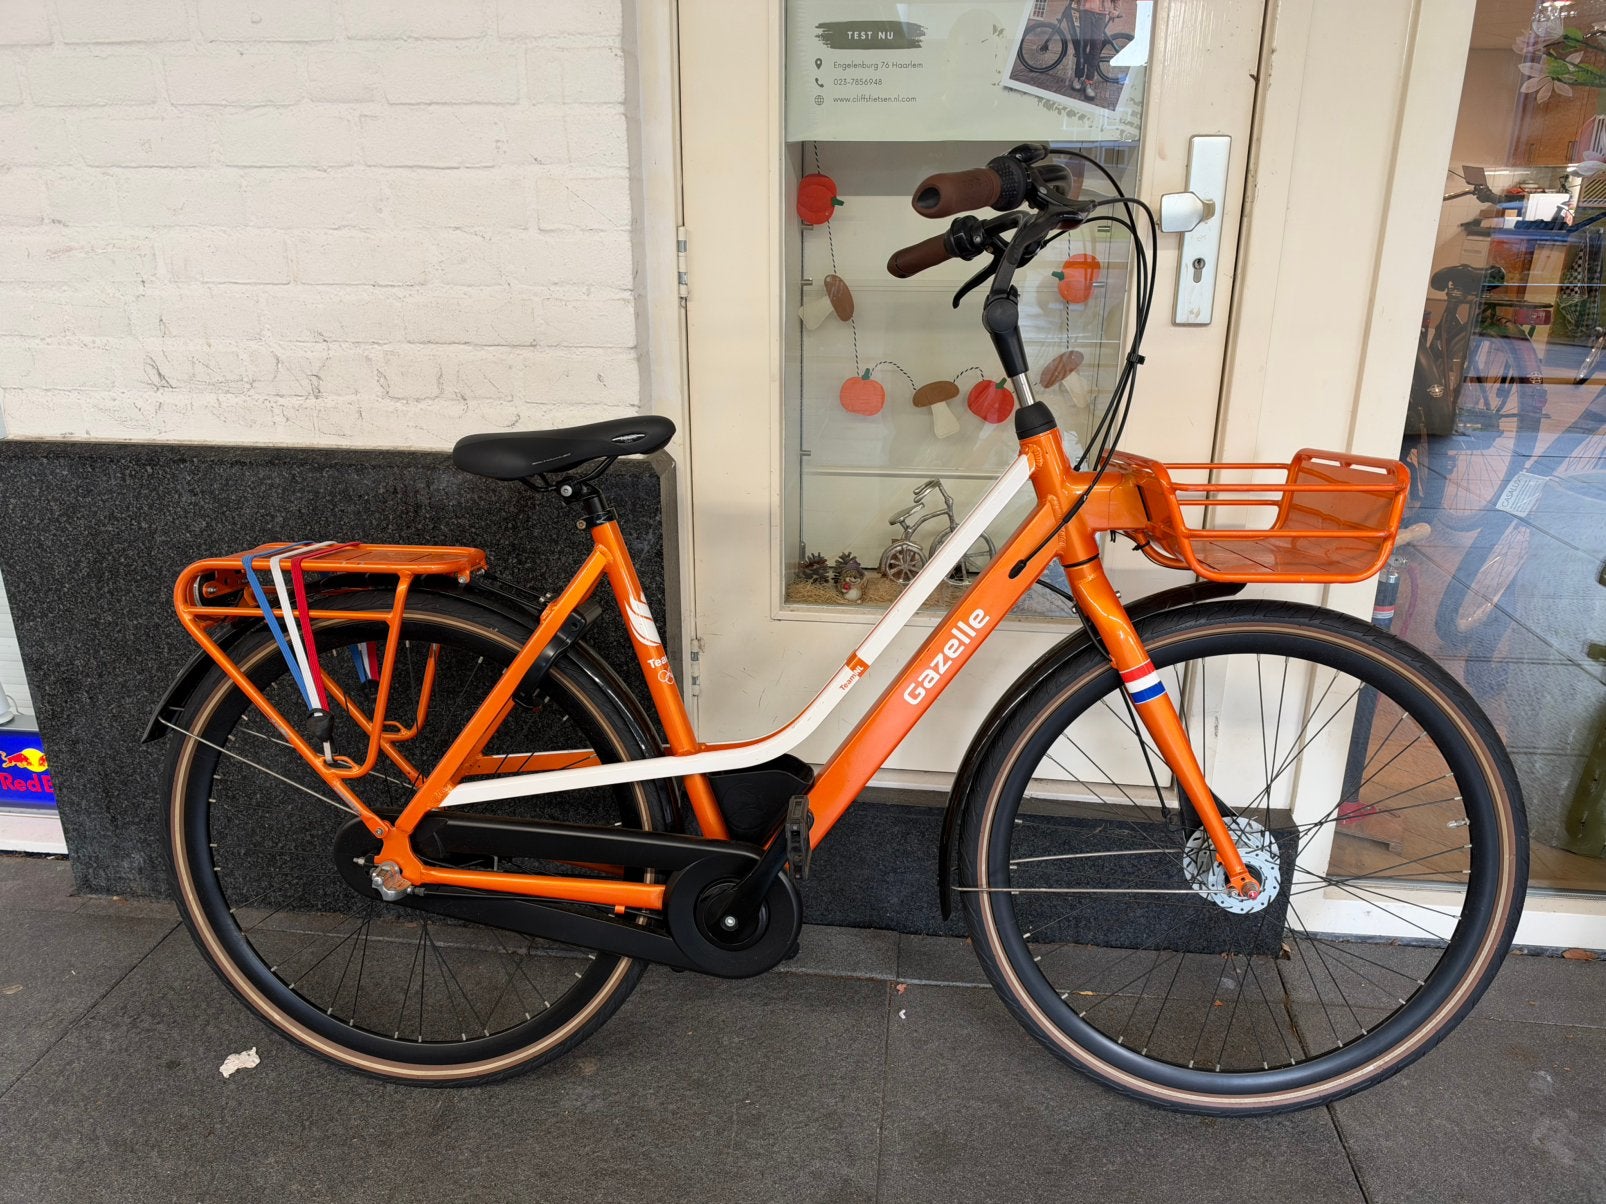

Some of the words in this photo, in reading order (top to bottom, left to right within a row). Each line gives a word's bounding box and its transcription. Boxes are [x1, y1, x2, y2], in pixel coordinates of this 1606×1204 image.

[847, 31, 873, 40] TEST
[878, 31, 894, 40] NU
[833, 60, 879, 71] Engelenburg
[880, 61, 890, 69] 76
[891, 60, 924, 69] Haarlem
[833, 78, 883, 86] 023-7856948
[903, 608, 990, 705] Gazelle
[839, 665, 864, 691] TeamNL
[0, 772, 42, 793] Red
